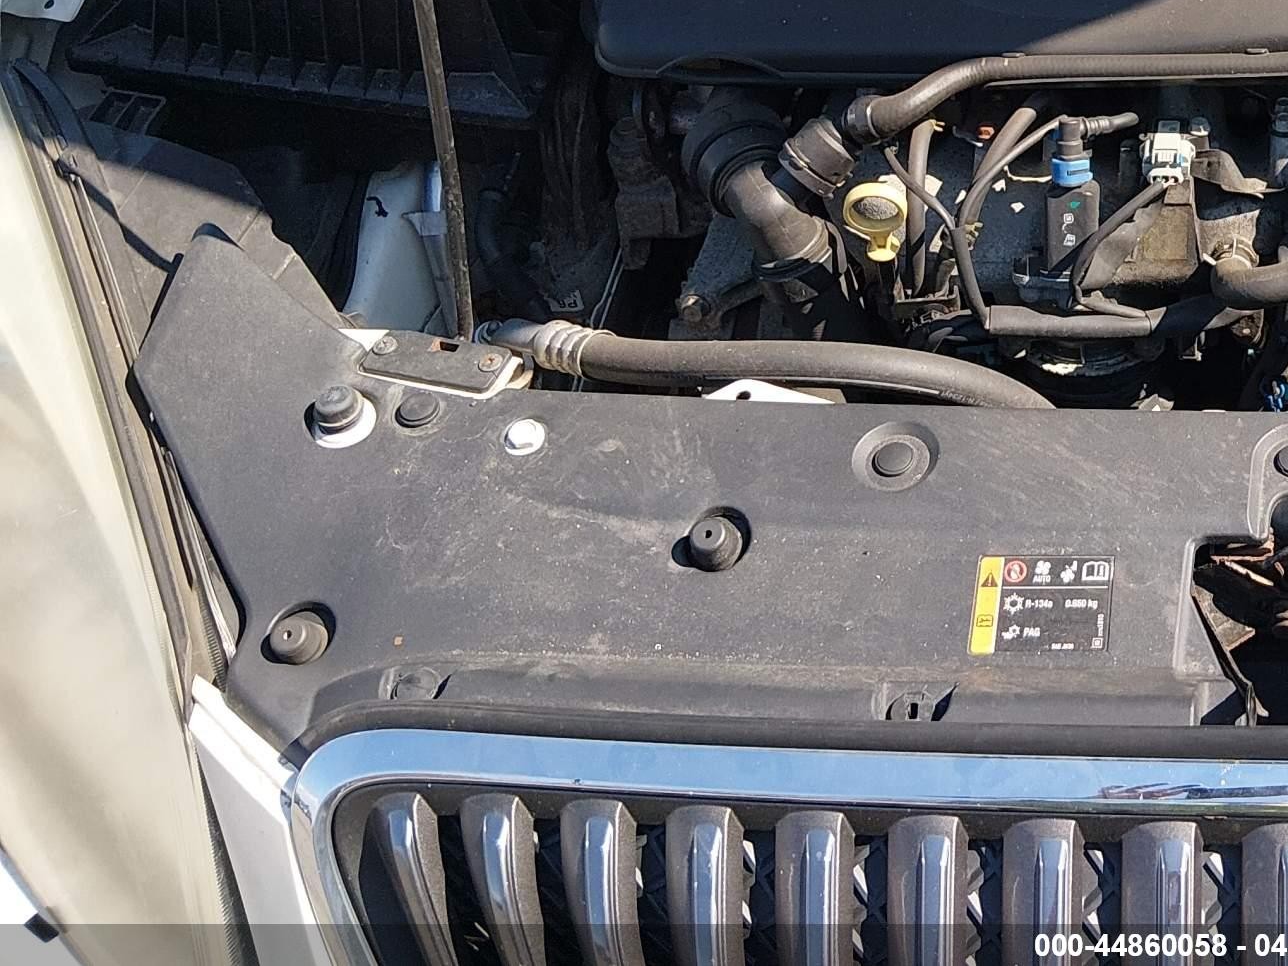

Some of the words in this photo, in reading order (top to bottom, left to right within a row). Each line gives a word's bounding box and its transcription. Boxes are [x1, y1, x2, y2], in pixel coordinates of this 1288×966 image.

[1032, 574, 1052, 584] AUTO
[1025, 598, 1053, 609] R-134a
[1087, 598, 1098, 610] kg
[1023, 626, 1041, 638] PAG
